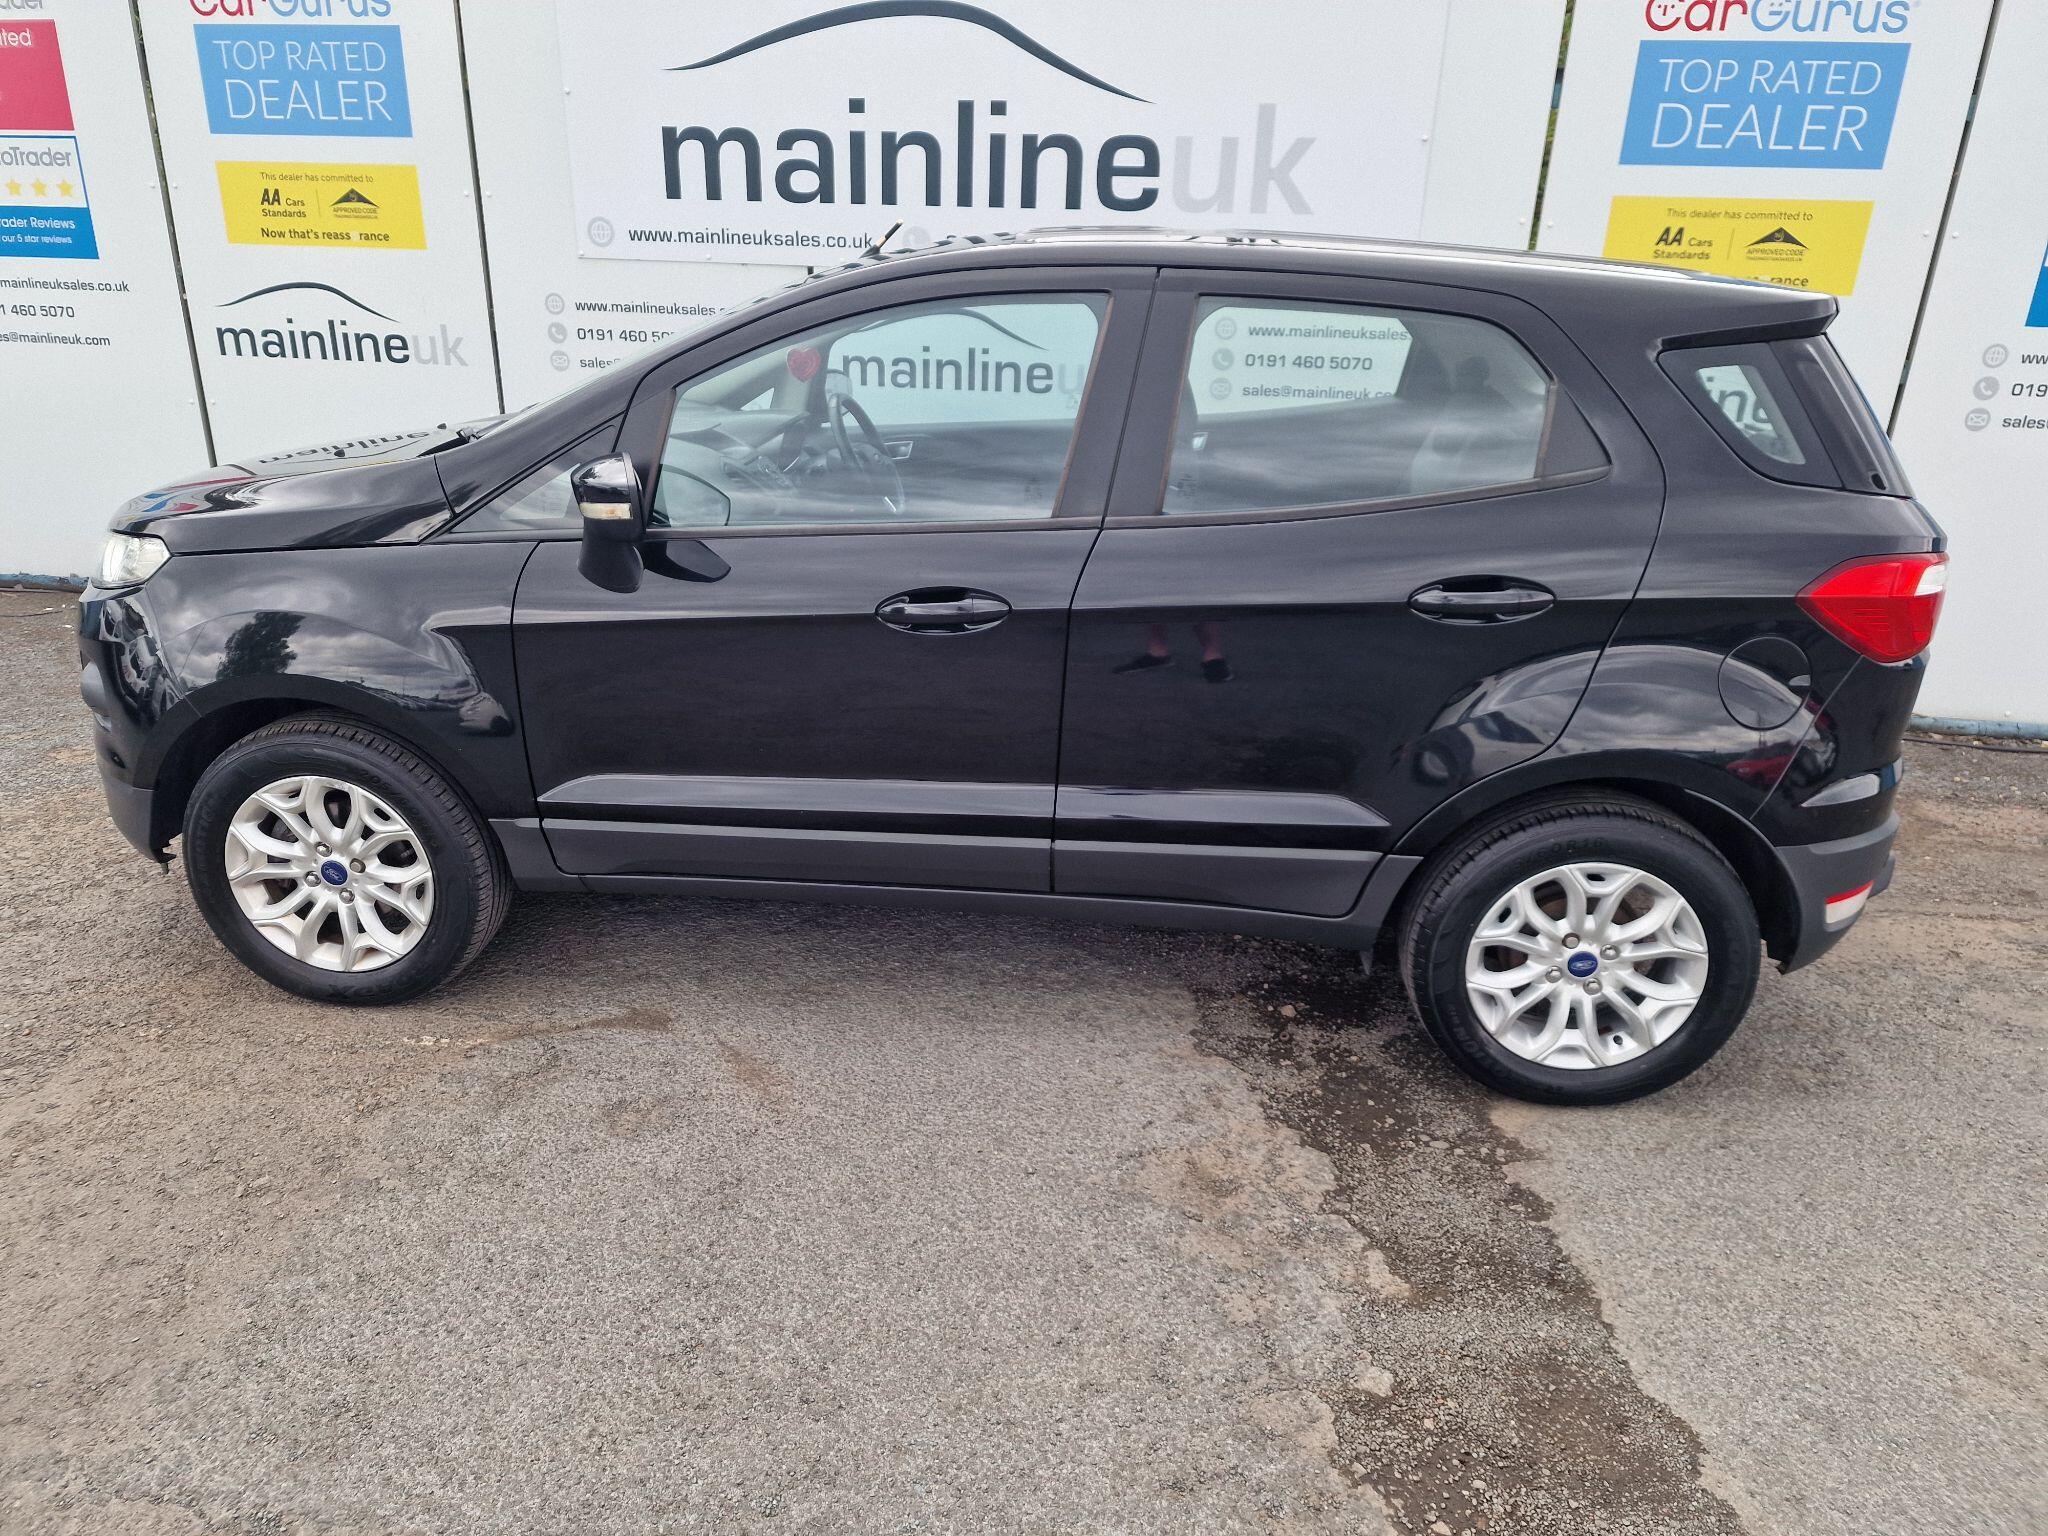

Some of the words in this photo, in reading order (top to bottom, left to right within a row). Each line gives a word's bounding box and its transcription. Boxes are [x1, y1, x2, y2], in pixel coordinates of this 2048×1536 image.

[1645, 0, 1910, 33] CarGurus
[0, 27, 32, 46] ted
[212, 40, 275, 71] TOP
[285, 41, 387, 72] RATED
[1658, 58, 1739, 94] TOP
[1749, 60, 1882, 96] RATED
[224, 79, 393, 121] DEALER
[1651, 102, 1868, 152] DEALER
[0, 146, 72, 167] oTrader
[660, 97, 1318, 216] mainlineuk
[260, 172, 277, 181] This
[279, 172, 303, 182] dealer
[305, 173, 319, 182] has
[321, 174, 364, 183] committed
[365, 175, 374, 183] to
[260, 188, 281, 206] AA
[285, 198, 306, 207] Cars
[261, 208, 307, 218] Standards
[1667, 208, 1687, 218] This
[1689, 208, 1722, 219] dealer
[1724, 210, 1742, 220] has
[1744, 211, 1800, 221] committed
[1802, 212, 1813, 222] to
[30, 216, 76, 230] Reviews
[17, 233, 23, 243] 5
[260, 227, 286, 239] Now
[288, 228, 319, 240] that's
[322, 230, 390, 242] reassrance
[628, 227, 873, 250] www.mainlineuksales.co.uk
[1655, 226, 1685, 246] AA
[1687, 237, 1713, 247] Cars
[1653, 249, 1710, 260] Standards
[10, 304, 37, 317] 460
[39, 305, 75, 318] 5070
[0, 332, 111, 347] s@mainlineuk.com
[216, 318, 468, 368] mainlineuk
[577, 327, 614, 341] 0191
[618, 330, 648, 343] 460
[1244, 353, 1286, 368] 0191
[1292, 354, 1325, 369] 460
[1329, 356, 1373, 371] 5070
